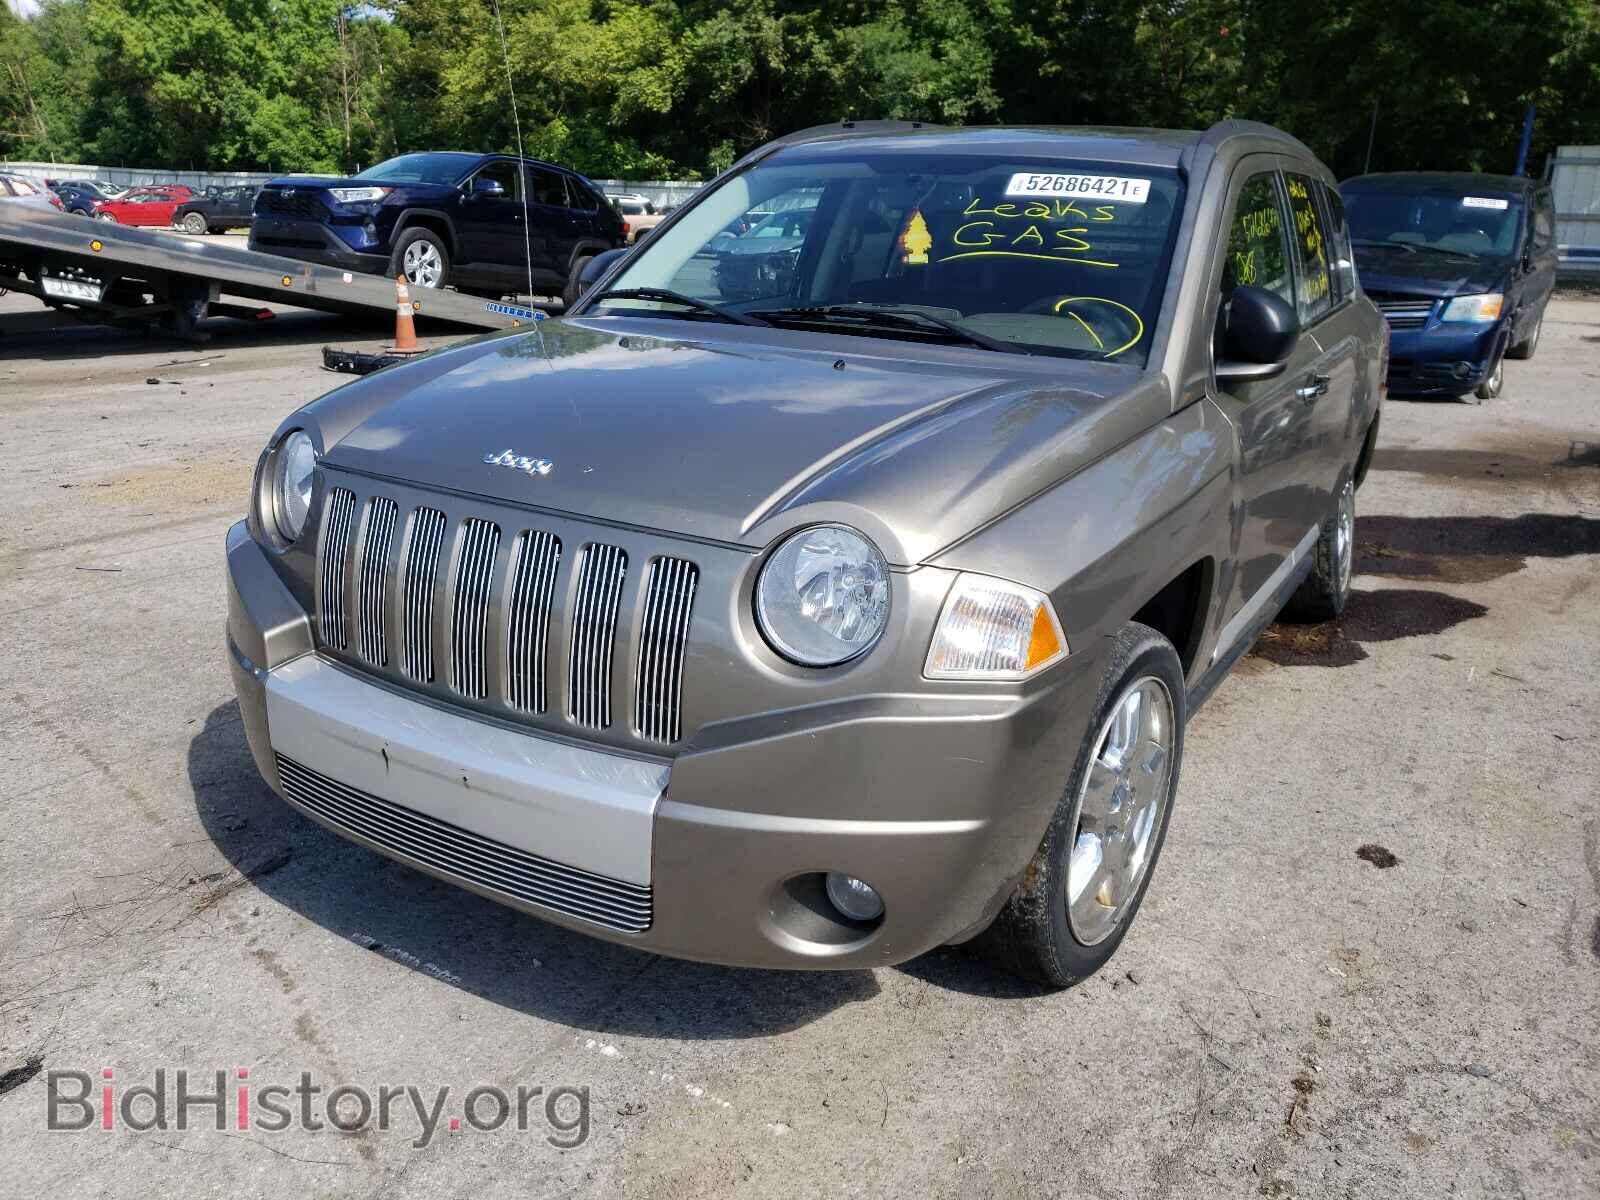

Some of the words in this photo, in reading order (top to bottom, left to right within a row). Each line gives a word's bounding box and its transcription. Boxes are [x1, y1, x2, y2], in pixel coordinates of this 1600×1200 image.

[1026, 175, 1130, 196] 52686421
[953, 221, 1091, 251] GAS
[482, 448, 554, 476] Jeep
